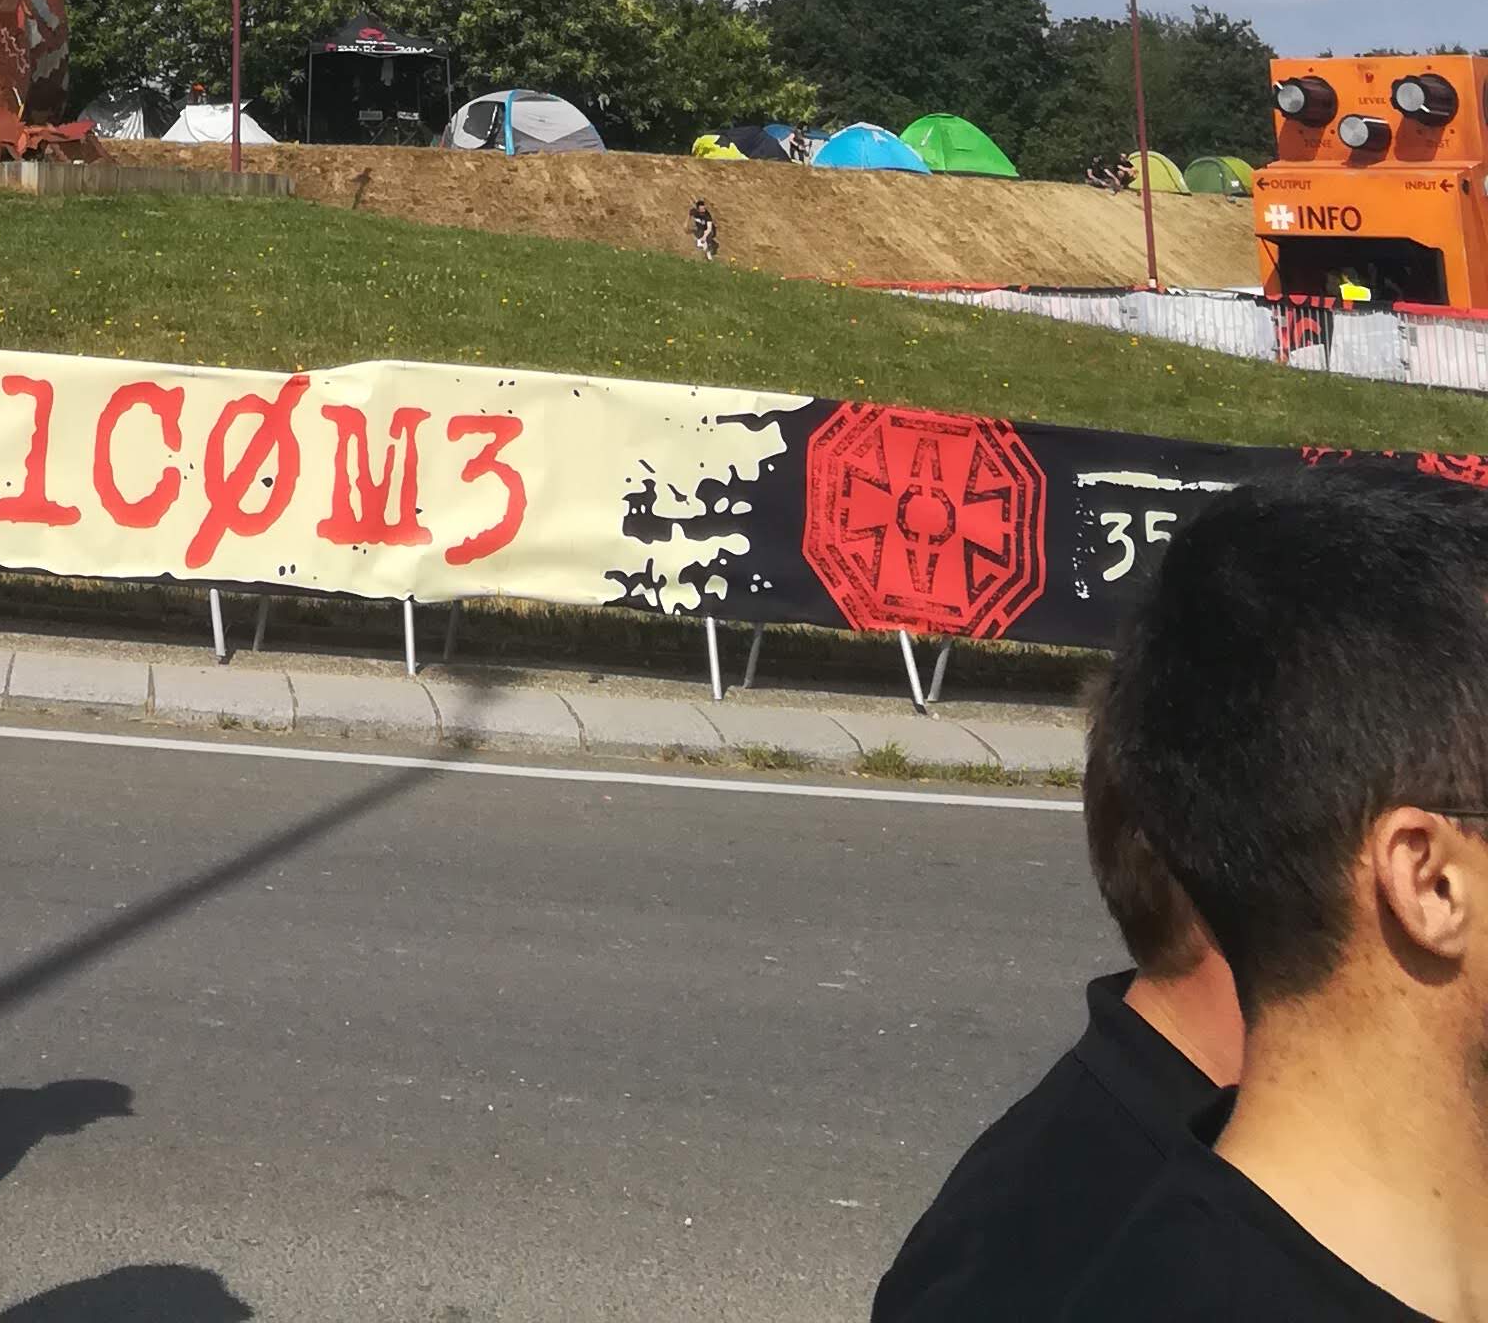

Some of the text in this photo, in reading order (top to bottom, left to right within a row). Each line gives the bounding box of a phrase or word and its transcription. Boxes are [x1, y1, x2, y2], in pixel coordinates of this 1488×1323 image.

[1358, 96, 1387, 105] LEVEL
[1270, 178, 1312, 191] OUTPUT
[1405, 179, 1437, 192] INPUT
[1297, 205, 1362, 232] INFO
